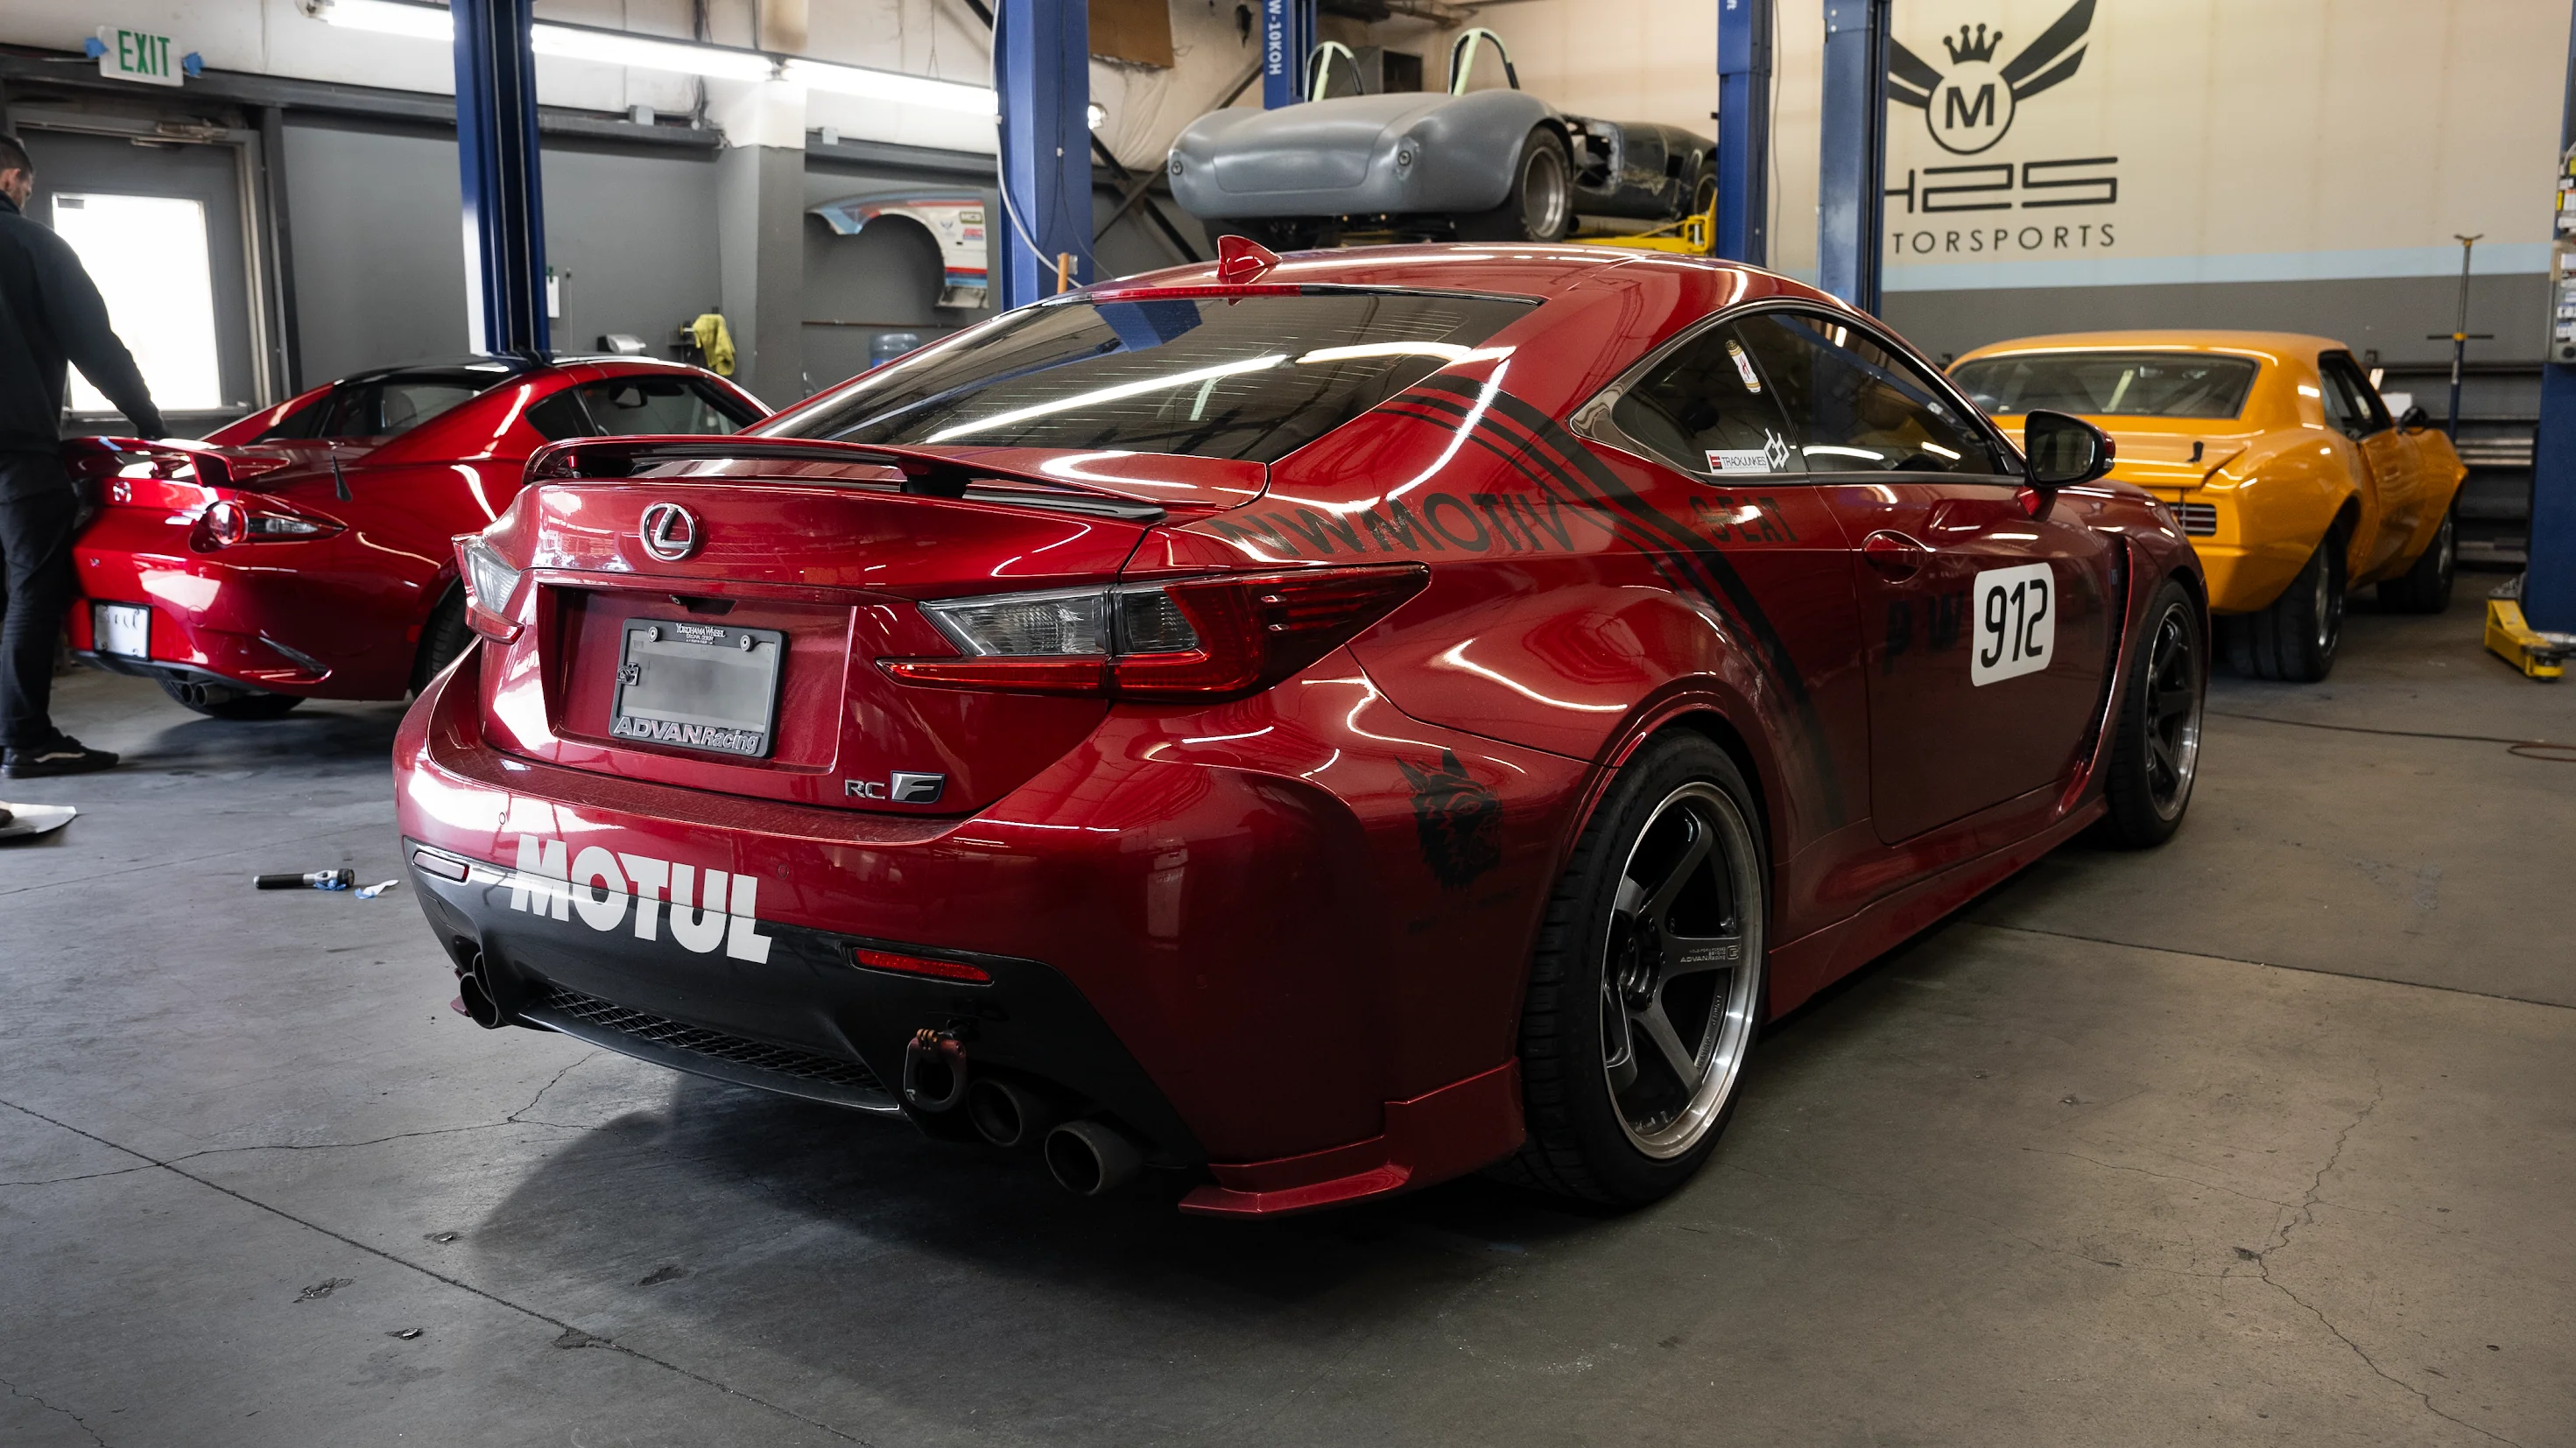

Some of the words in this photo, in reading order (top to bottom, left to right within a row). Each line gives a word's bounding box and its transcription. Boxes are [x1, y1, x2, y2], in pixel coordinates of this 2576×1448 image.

[117, 30, 171, 77] EXIT
[1945, 83, 1995, 130] M
[1892, 223, 2115, 254] TORSPORTS
[1981, 579, 2048, 668] 912
[844, 779, 886, 800] RC
[510, 833, 772, 965] MOTUL
